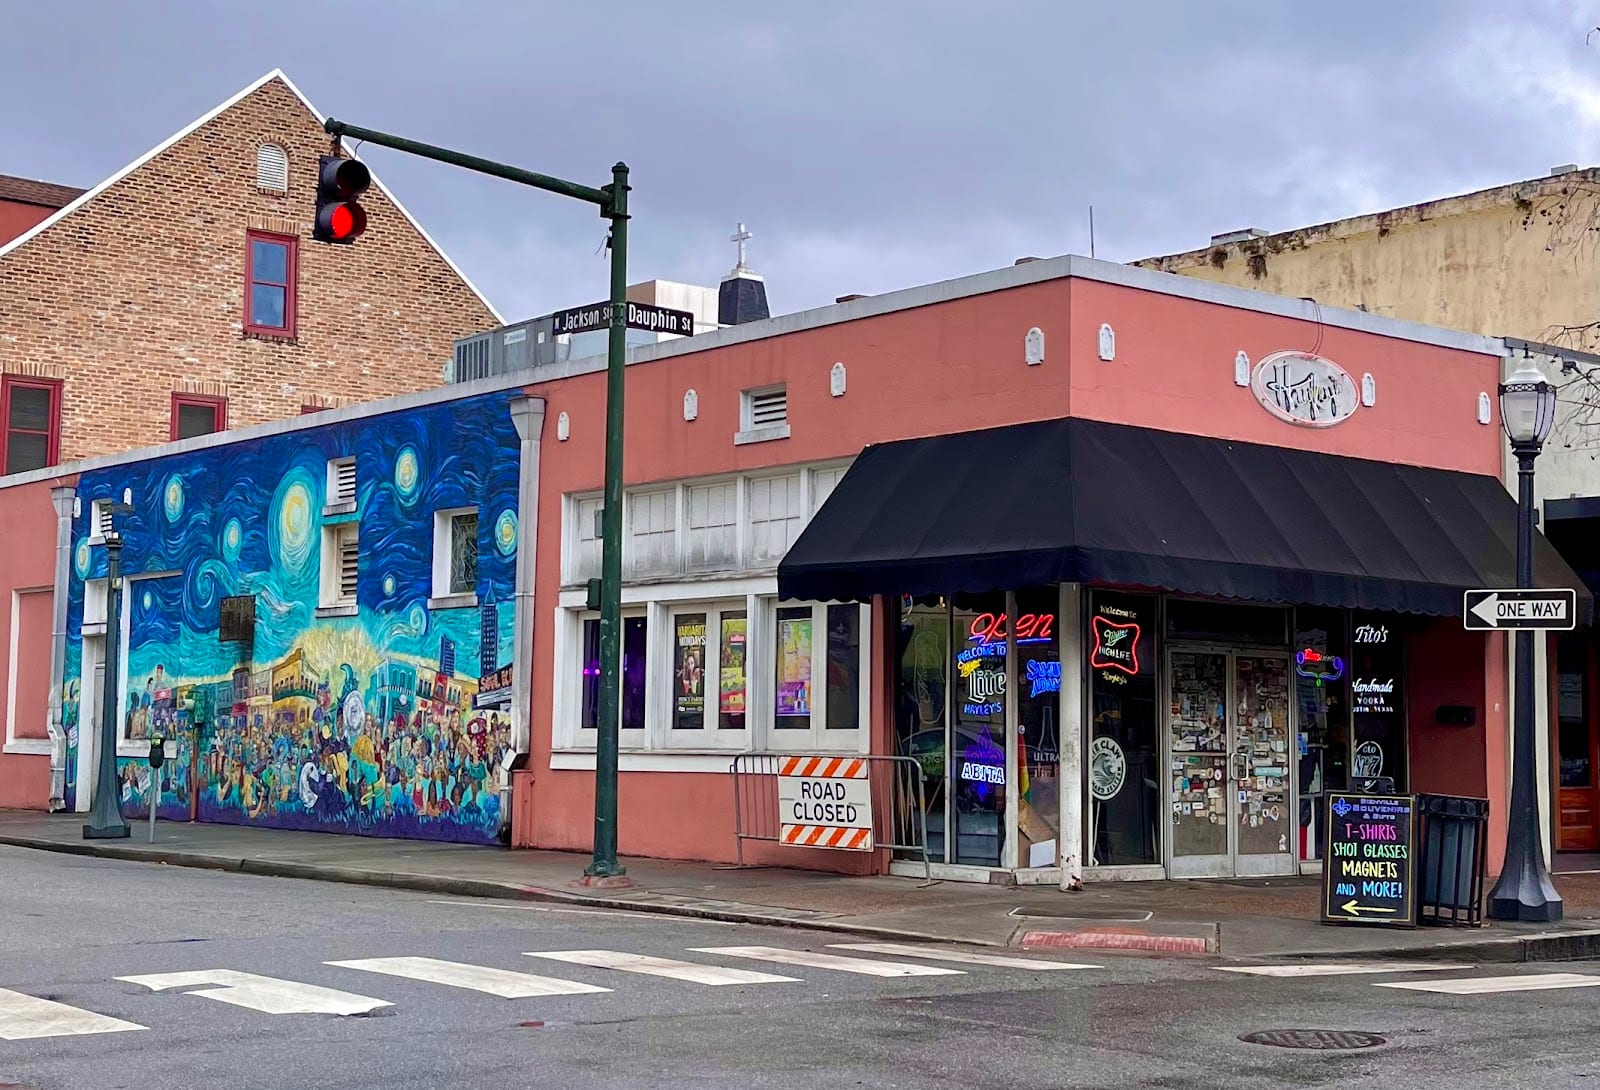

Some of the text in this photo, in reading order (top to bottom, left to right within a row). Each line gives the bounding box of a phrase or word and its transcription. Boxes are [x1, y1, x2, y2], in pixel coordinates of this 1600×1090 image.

[554, 317, 559, 329] N
[562, 310, 599, 331] Jackson
[628, 304, 691, 331] Dauphin St
[1497, 603, 1562, 617] ONE WAY
[1354, 624, 1389, 643] Tito's
[957, 645, 995, 662] WELCOME
[996, 644, 1006, 656] TO
[1099, 646, 1130, 660] HIGH LIFE
[968, 669, 1006, 701] Lite
[1352, 678, 1393, 693] Handmade
[964, 702, 1002, 715] HAYLEY'S
[1033, 752, 1060, 762] ULTRA
[1101, 740, 1121, 759] CLAW
[961, 762, 1005, 784] ABITA
[801, 781, 846, 801] ROAD
[1352, 804, 1410, 813] SOUVENIRS
[1360, 798, 1399, 806] BIENVILLE
[793, 802, 857, 823] CLOSED
[1345, 823, 1397, 841] T-SHIRTS
[1333, 842, 1408, 860] SHOT GLASSES
[1342, 860, 1398, 878] MAGNETS
[1335, 880, 1403, 899] AND MORE!
